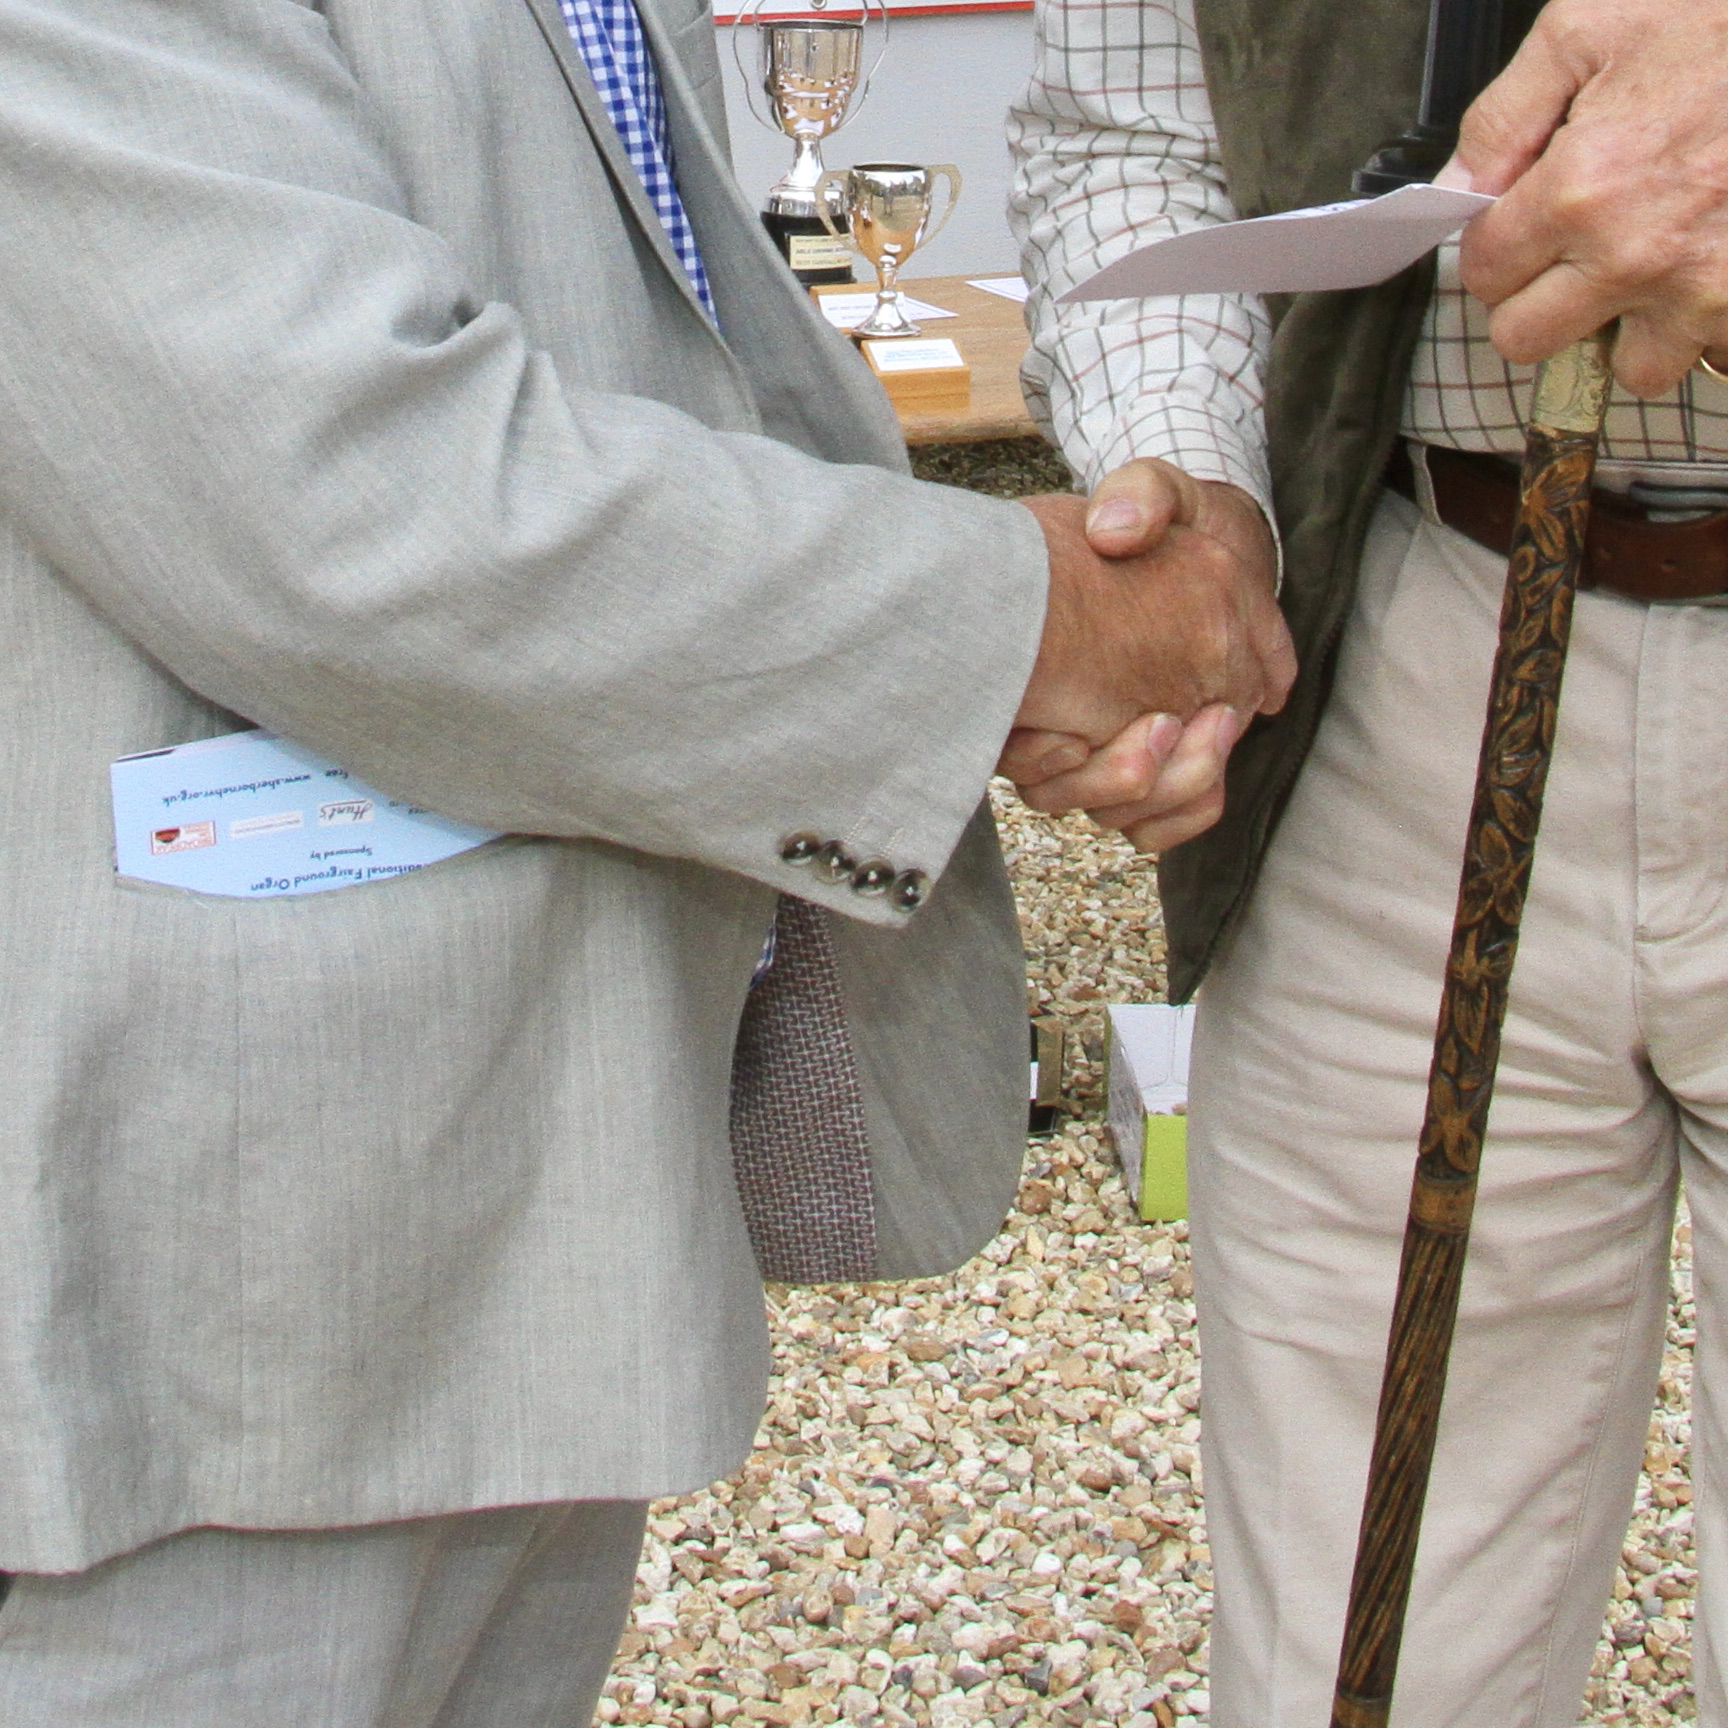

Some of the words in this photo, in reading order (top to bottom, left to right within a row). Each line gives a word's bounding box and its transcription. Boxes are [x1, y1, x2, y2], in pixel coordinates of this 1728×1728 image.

[310, 850, 322, 860] by
[323, 845, 373, 860] Sponsored
[294, 865, 363, 888] Fairground
[367, 863, 424, 879] aditional
[250, 876, 291, 892] Organ
